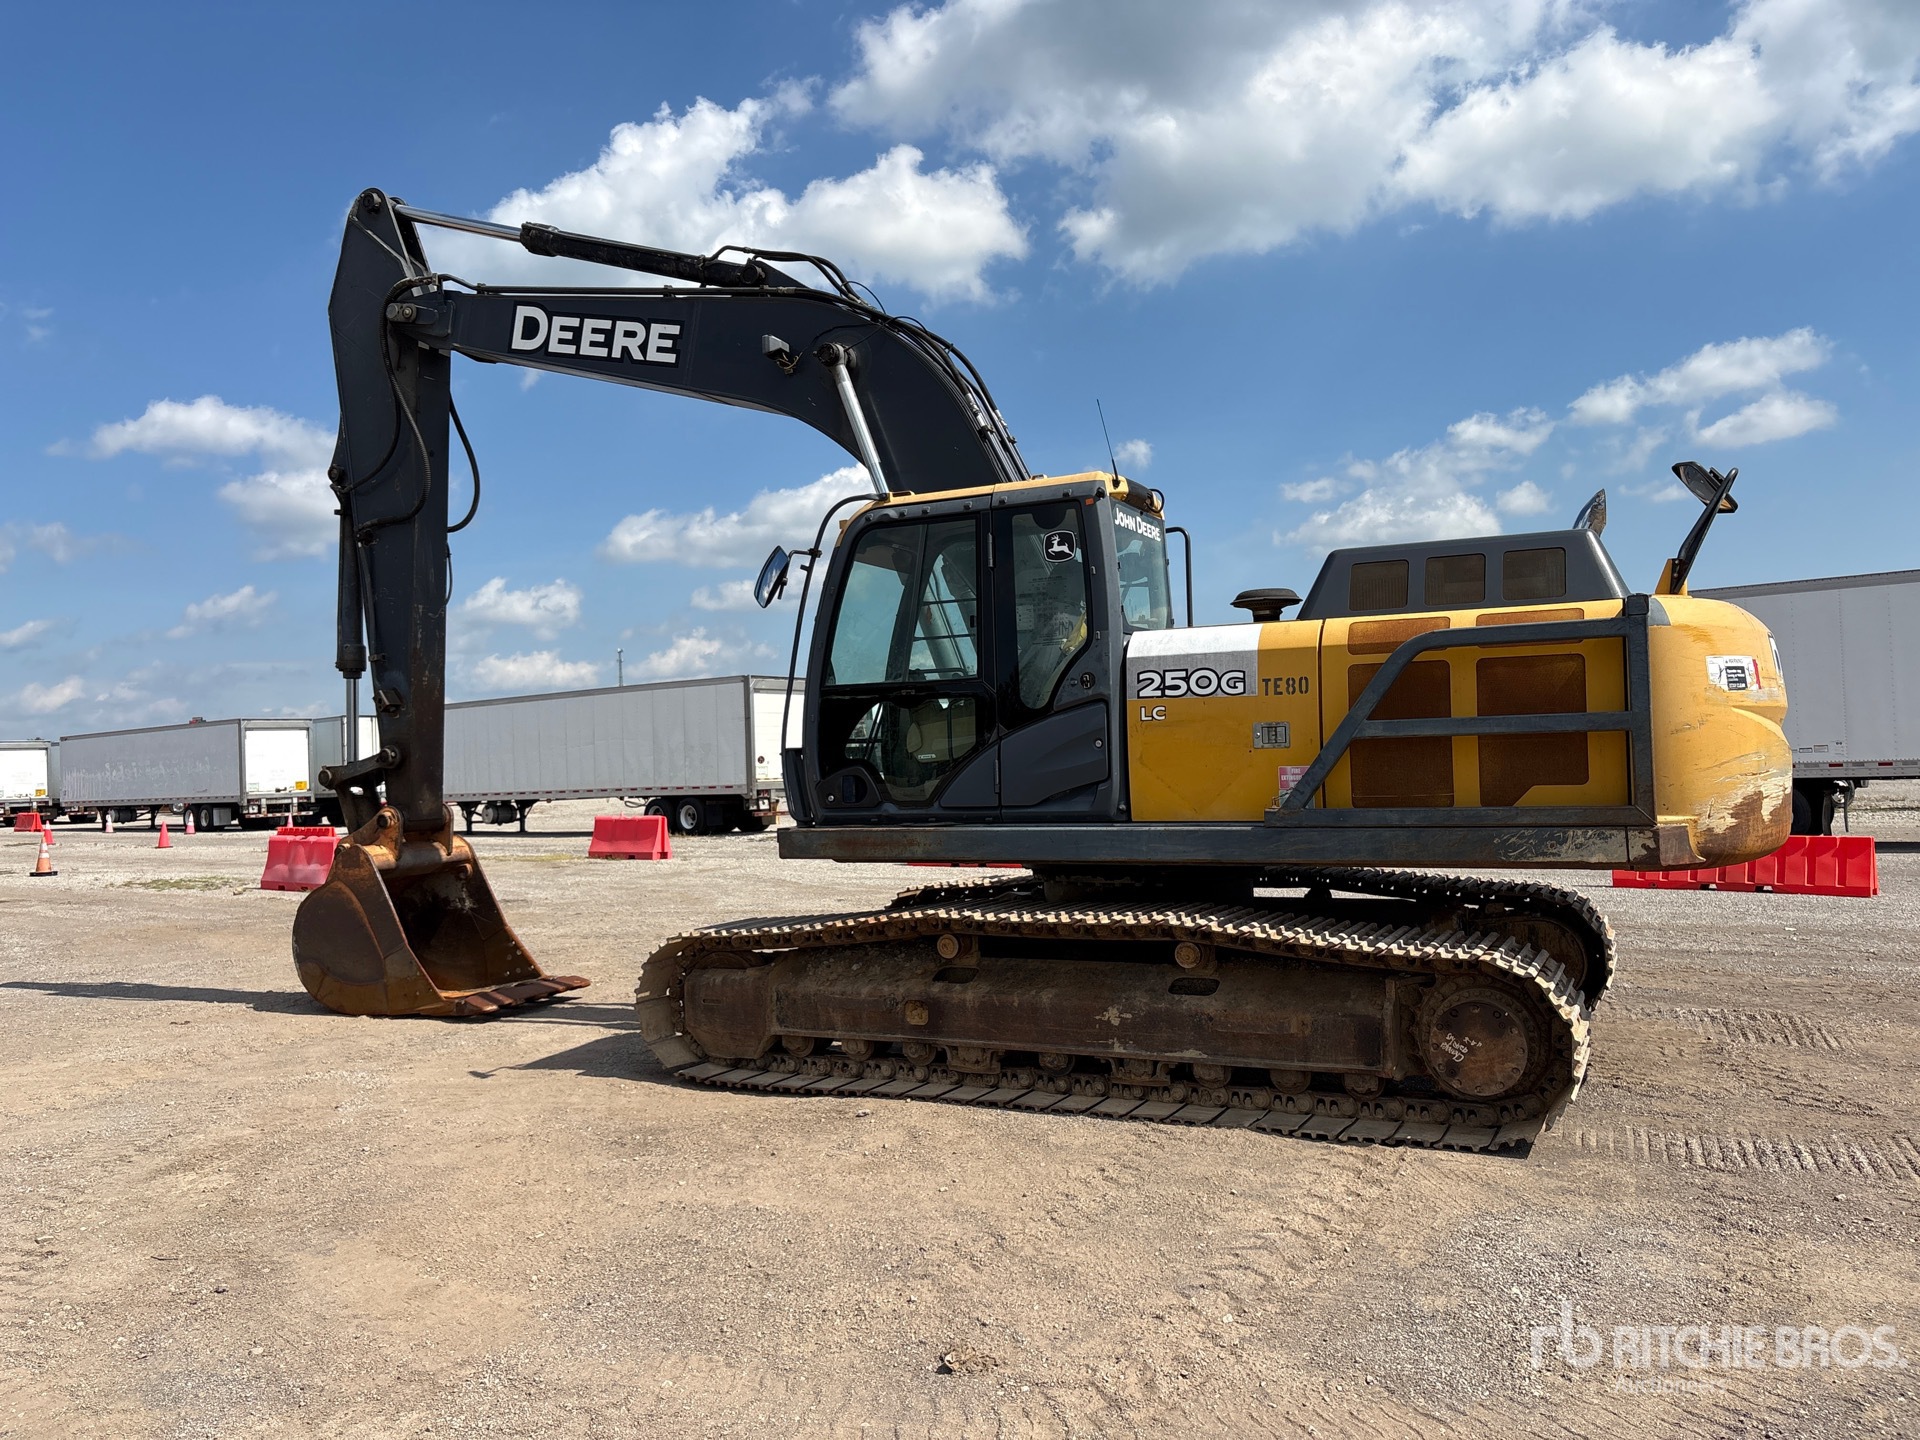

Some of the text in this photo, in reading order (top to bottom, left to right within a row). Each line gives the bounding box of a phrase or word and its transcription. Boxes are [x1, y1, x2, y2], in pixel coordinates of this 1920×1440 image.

[511, 305, 681, 364] DEERE
[1114, 507, 1161, 542] JOHN DEERE
[1137, 668, 1309, 698] 250G TE80
[1140, 706, 1166, 721] LC
